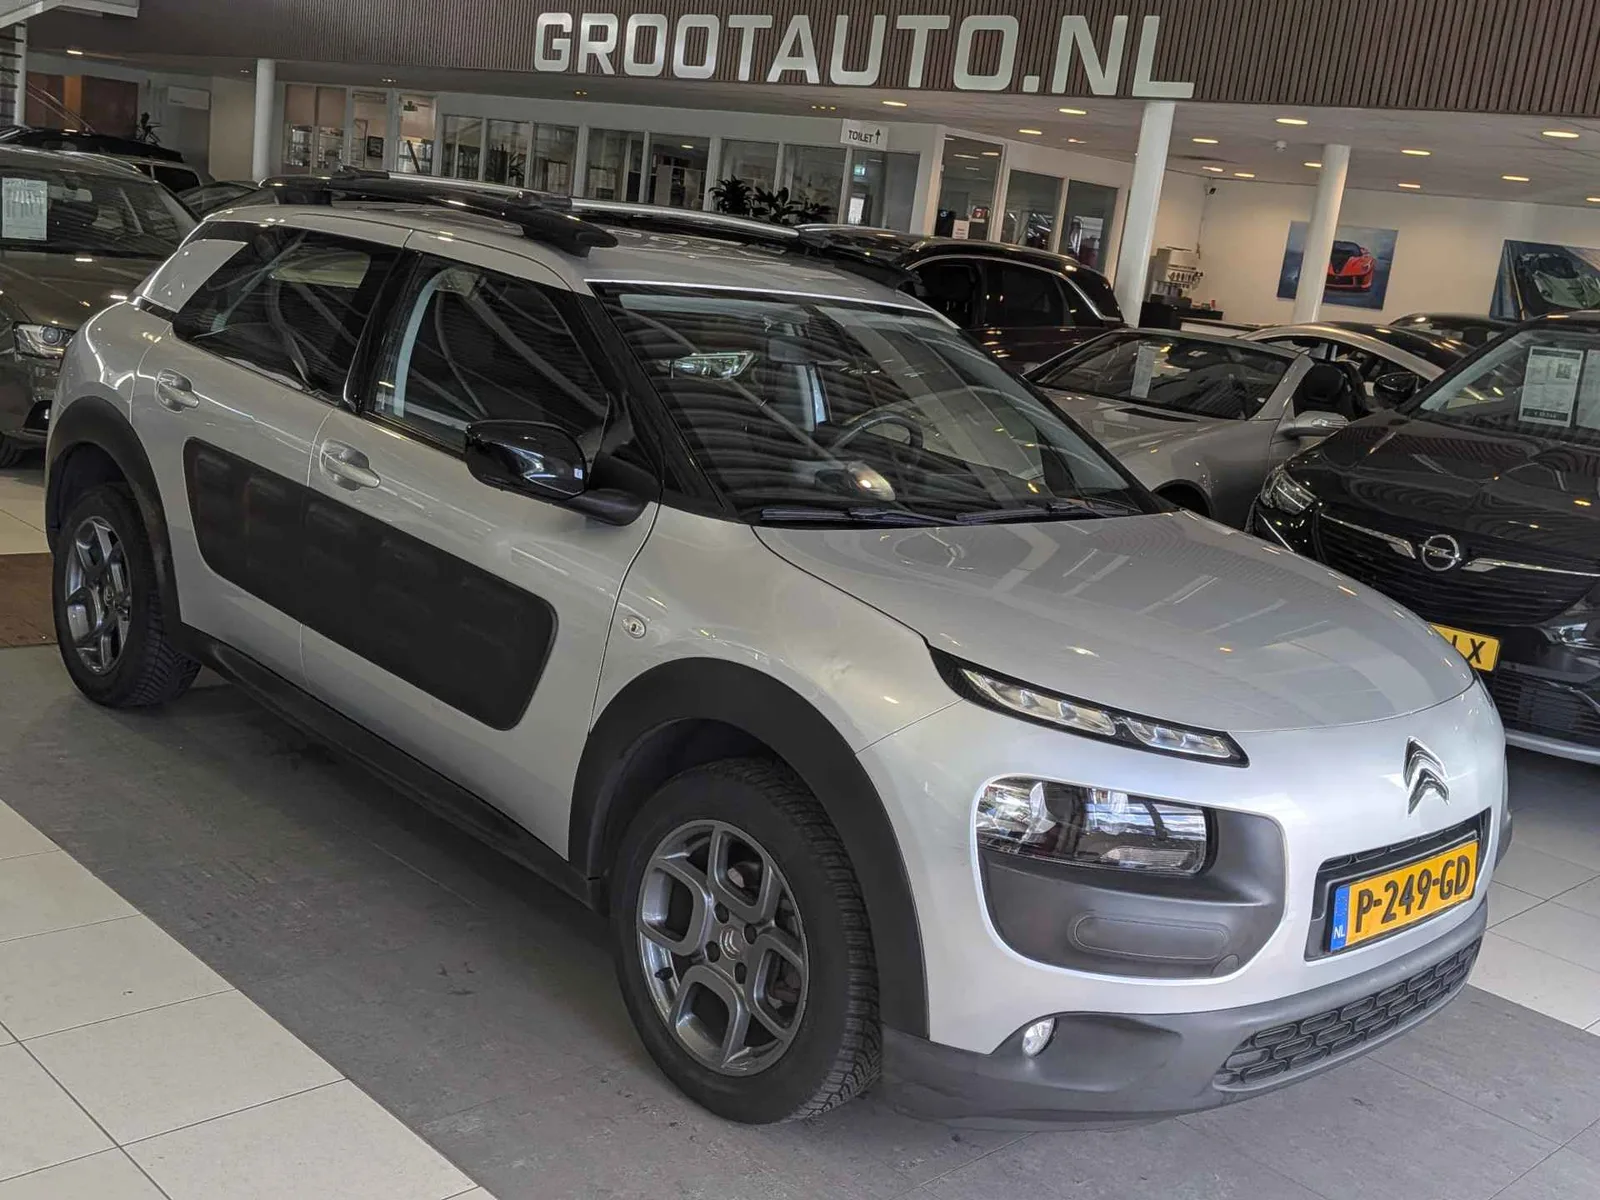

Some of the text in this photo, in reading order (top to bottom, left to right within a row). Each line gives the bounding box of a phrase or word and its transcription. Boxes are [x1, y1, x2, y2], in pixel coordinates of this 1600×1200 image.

[534, 12, 1195, 98] GROOTAUTO.NL
[848, 129, 873, 143] TOILET
[1356, 854, 1471, 934] P-249-GD
[1333, 926, 1346, 939] NL
